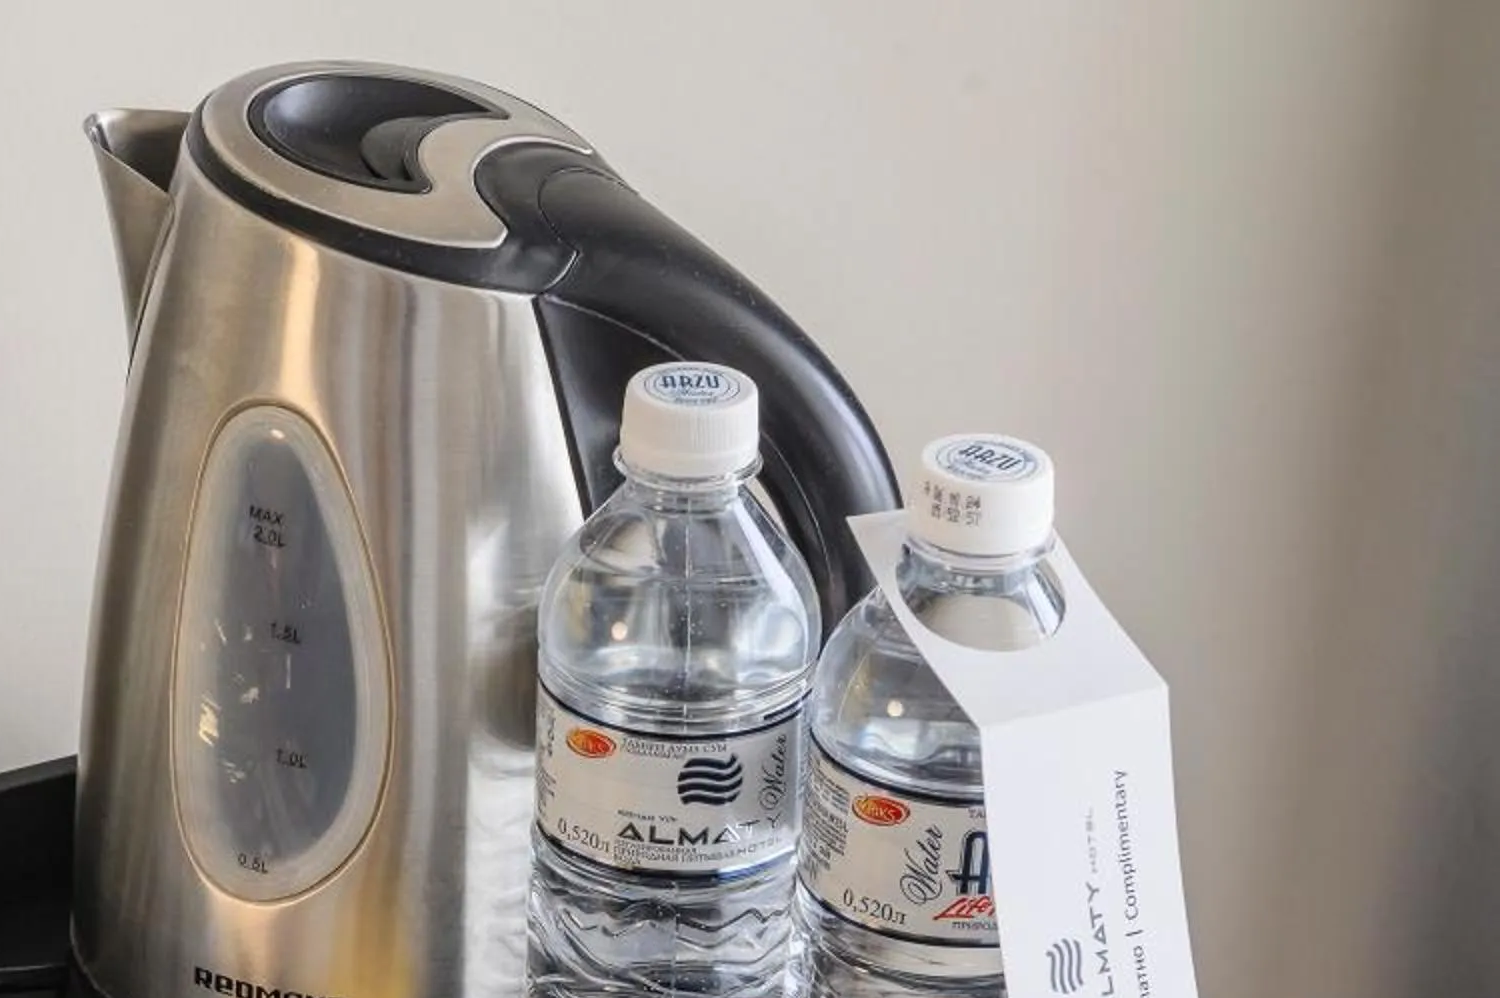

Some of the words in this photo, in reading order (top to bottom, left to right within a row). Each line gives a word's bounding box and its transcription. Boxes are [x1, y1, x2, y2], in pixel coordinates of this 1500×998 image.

[661, 374, 721, 389] ARZU
[249, 505, 284, 525] MAX
[617, 812, 782, 846] ALMATY
[1113, 768, 1140, 921] Complimentary
[899, 824, 944, 906] Water
[843, 888, 907, 926] 0,520л
